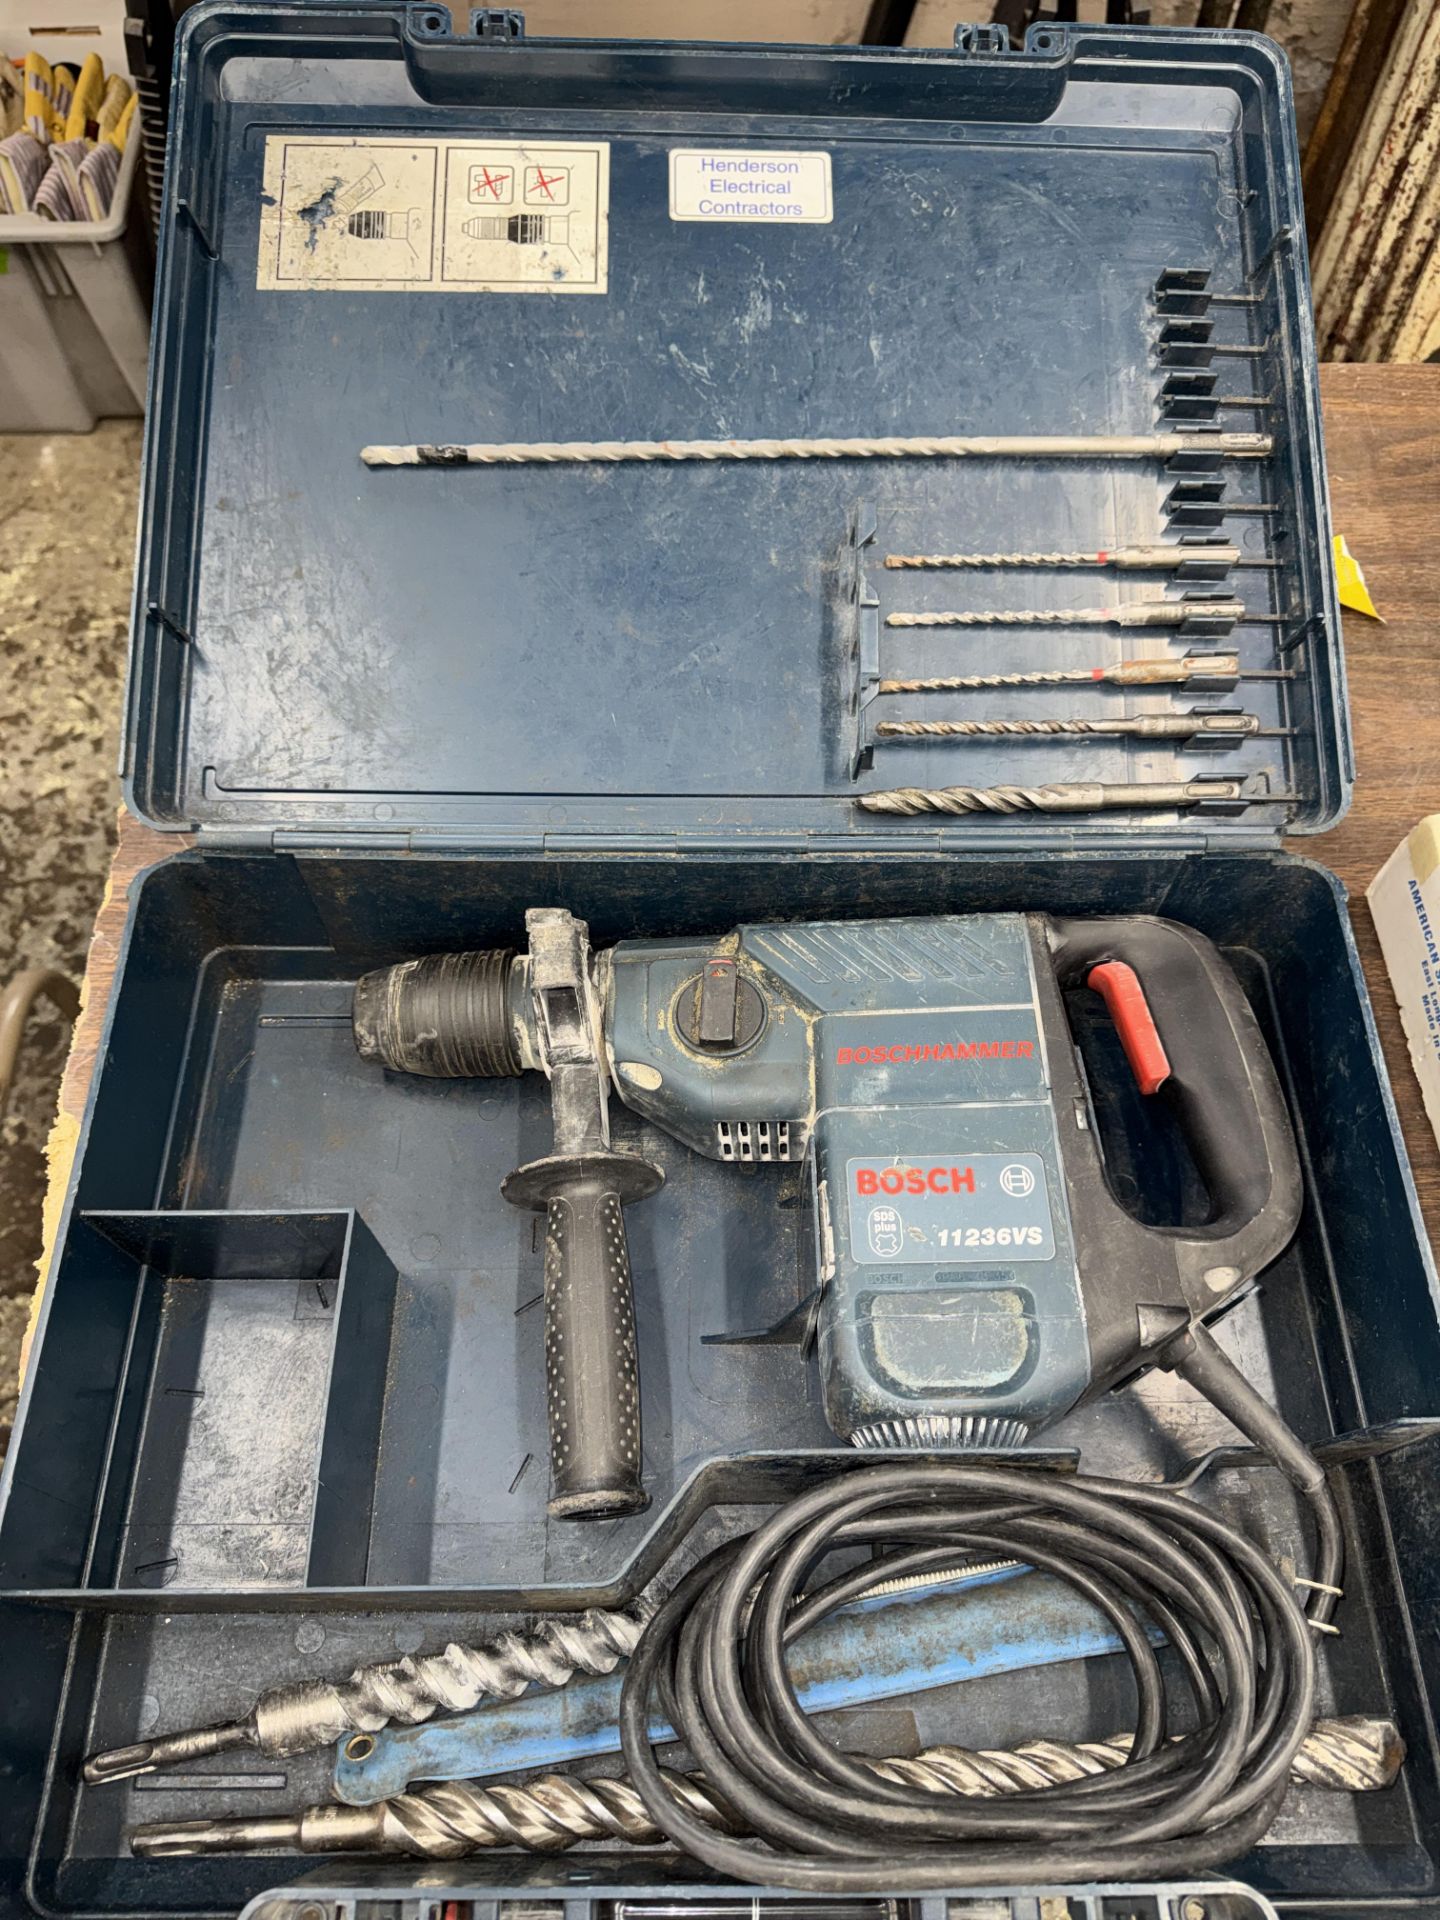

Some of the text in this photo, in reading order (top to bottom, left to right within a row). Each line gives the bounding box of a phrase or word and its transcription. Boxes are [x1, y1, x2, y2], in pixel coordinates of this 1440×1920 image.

[701, 158, 799, 173] Henderson
[710, 178, 791, 194] Electrical
[699, 200, 803, 215] Contractors
[1408, 880, 1440, 964] AMERICAN
[1422, 994, 1436, 1030] Made
[837, 1041, 1034, 1065] BOSCHHAMMER
[856, 1167, 976, 1195] BOSCH
[873, 1211, 895, 1222] SDS
[874, 1219, 896, 1234] plus
[938, 1227, 1043, 1247] 11236VS
